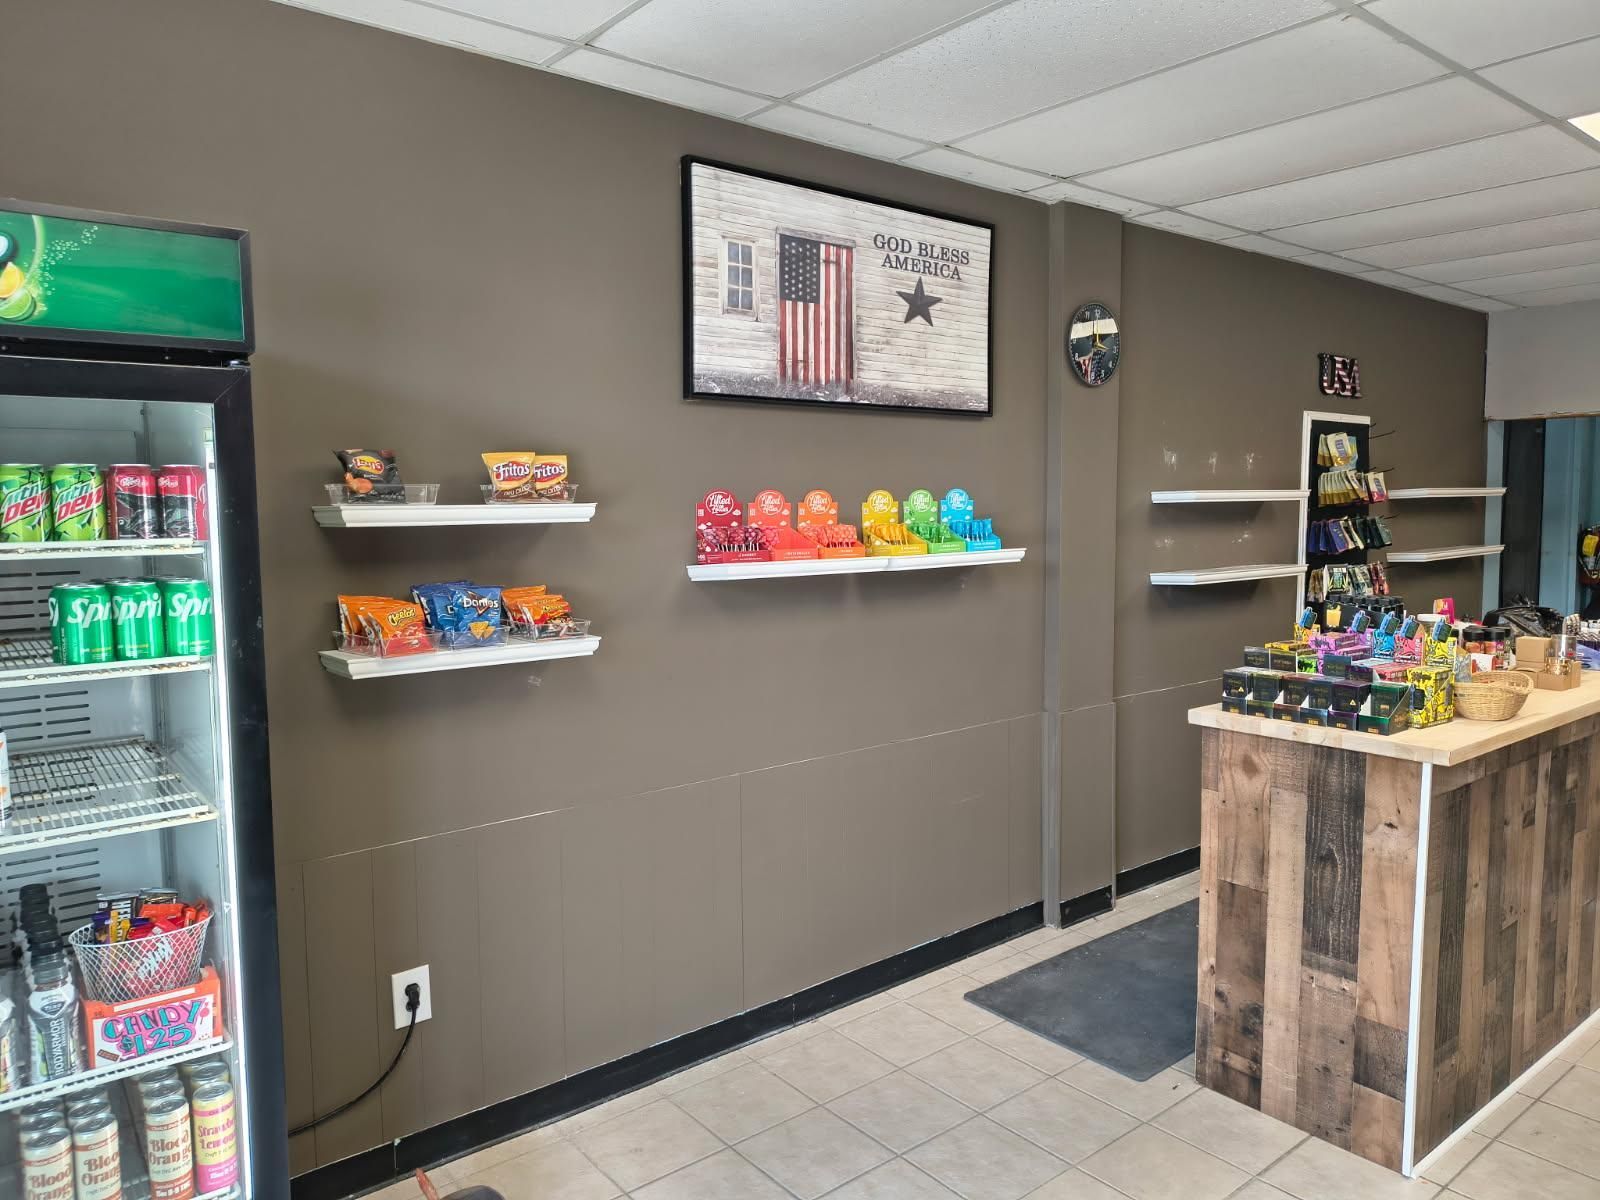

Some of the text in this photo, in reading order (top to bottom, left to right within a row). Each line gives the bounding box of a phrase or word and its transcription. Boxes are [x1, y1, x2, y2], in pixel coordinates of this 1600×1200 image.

[873, 233, 970, 265] GOD BLESS
[881, 253, 962, 280] AMERICA
[1318, 353, 1362, 399] USA
[493, 461, 530, 481] Fritos
[463, 595, 499, 609] Doritos
[103, 1000, 203, 1040] CANDY
